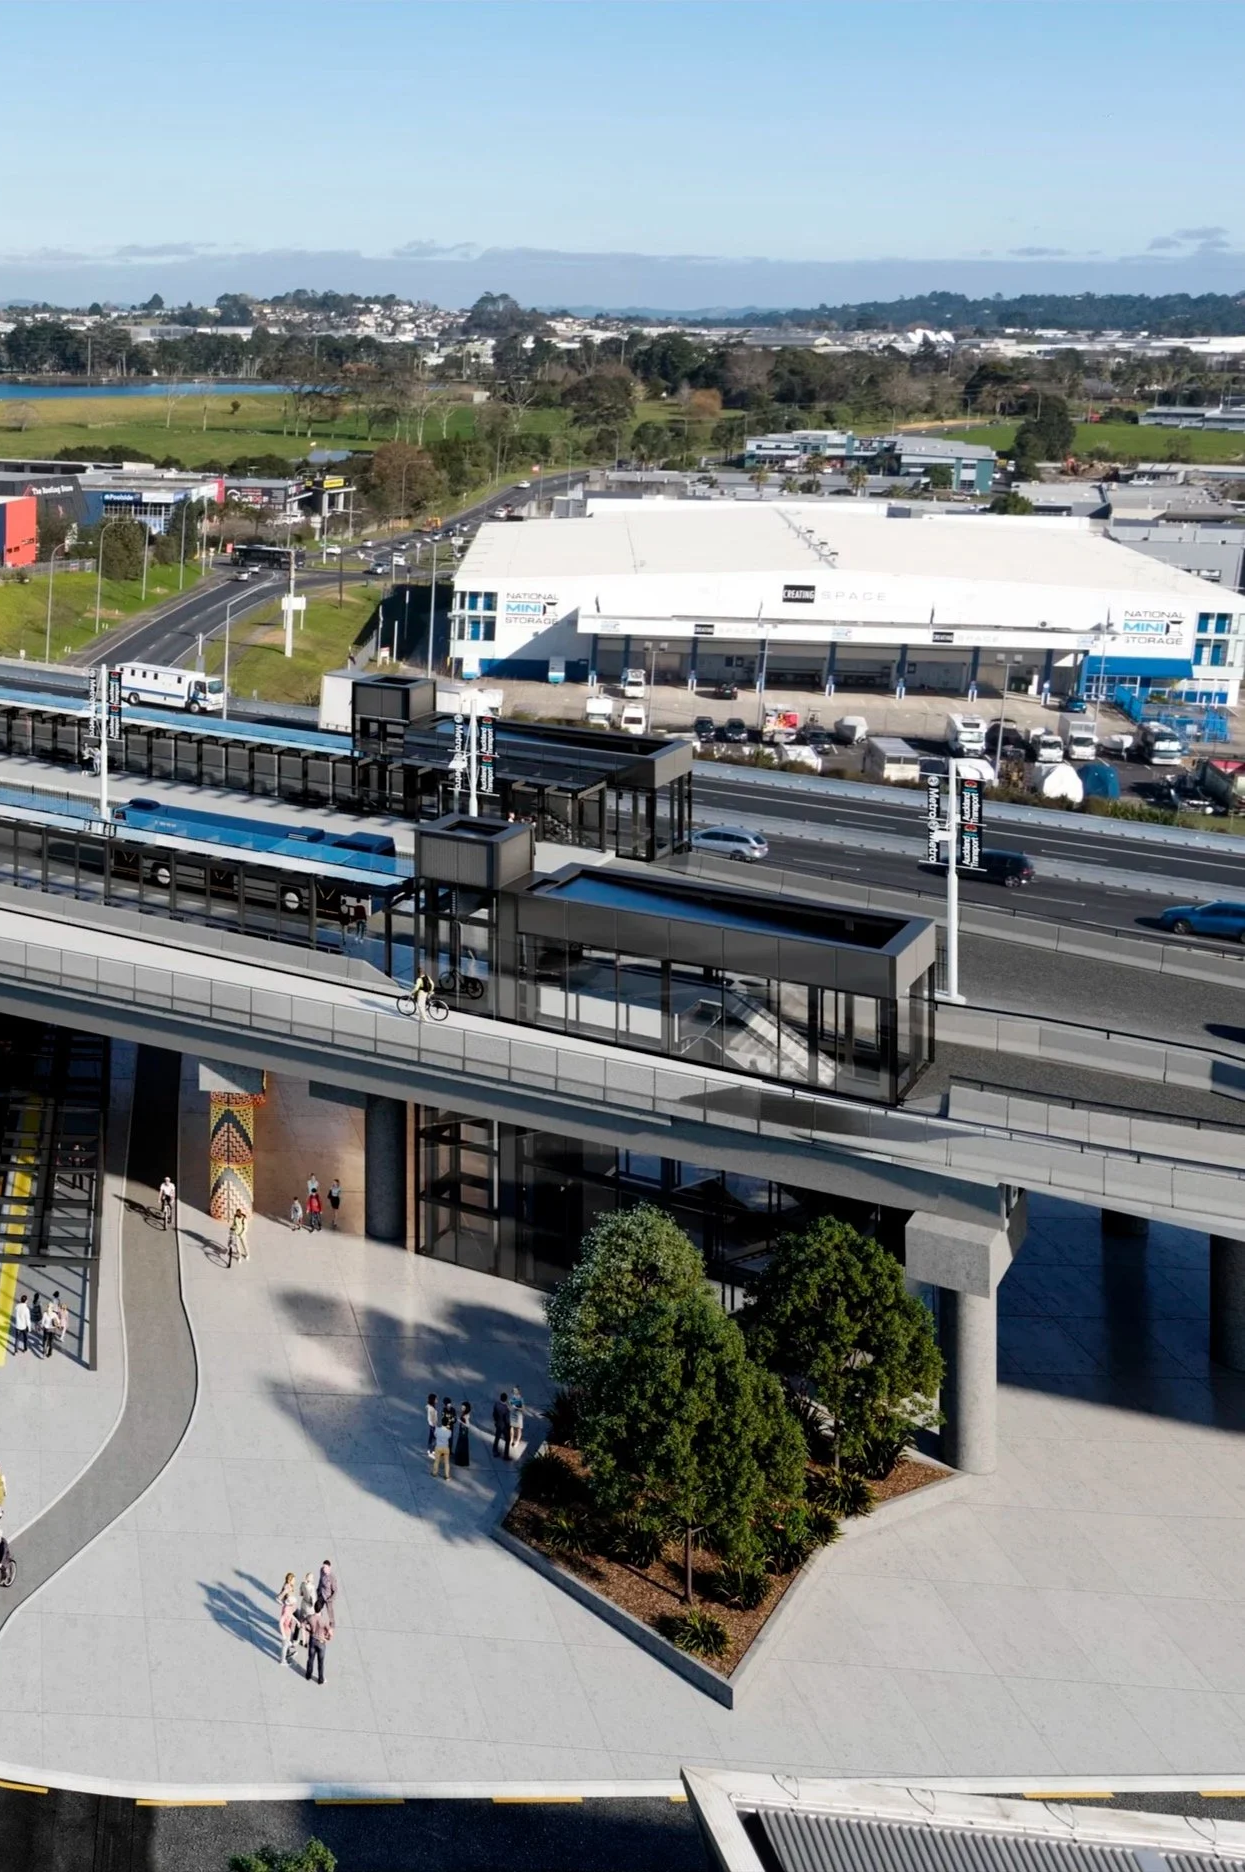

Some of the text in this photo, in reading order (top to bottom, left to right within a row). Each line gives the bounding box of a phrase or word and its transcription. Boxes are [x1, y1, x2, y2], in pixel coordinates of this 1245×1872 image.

[506, 592, 559, 600] NATIONAL
[782, 589, 887, 601] CREATING SPACE
[505, 603, 542, 613] MINI
[505, 616, 559, 625] STORAGE
[1124, 610, 1186, 619] NATIONAL
[1123, 622, 1164, 632] MINI
[928, 787, 940, 819] Metro
[962, 791, 971, 822] Auckland
[971, 793, 980, 824] Transport
[962, 835, 971, 867] Auckland
[971, 837, 980, 868] Transport
